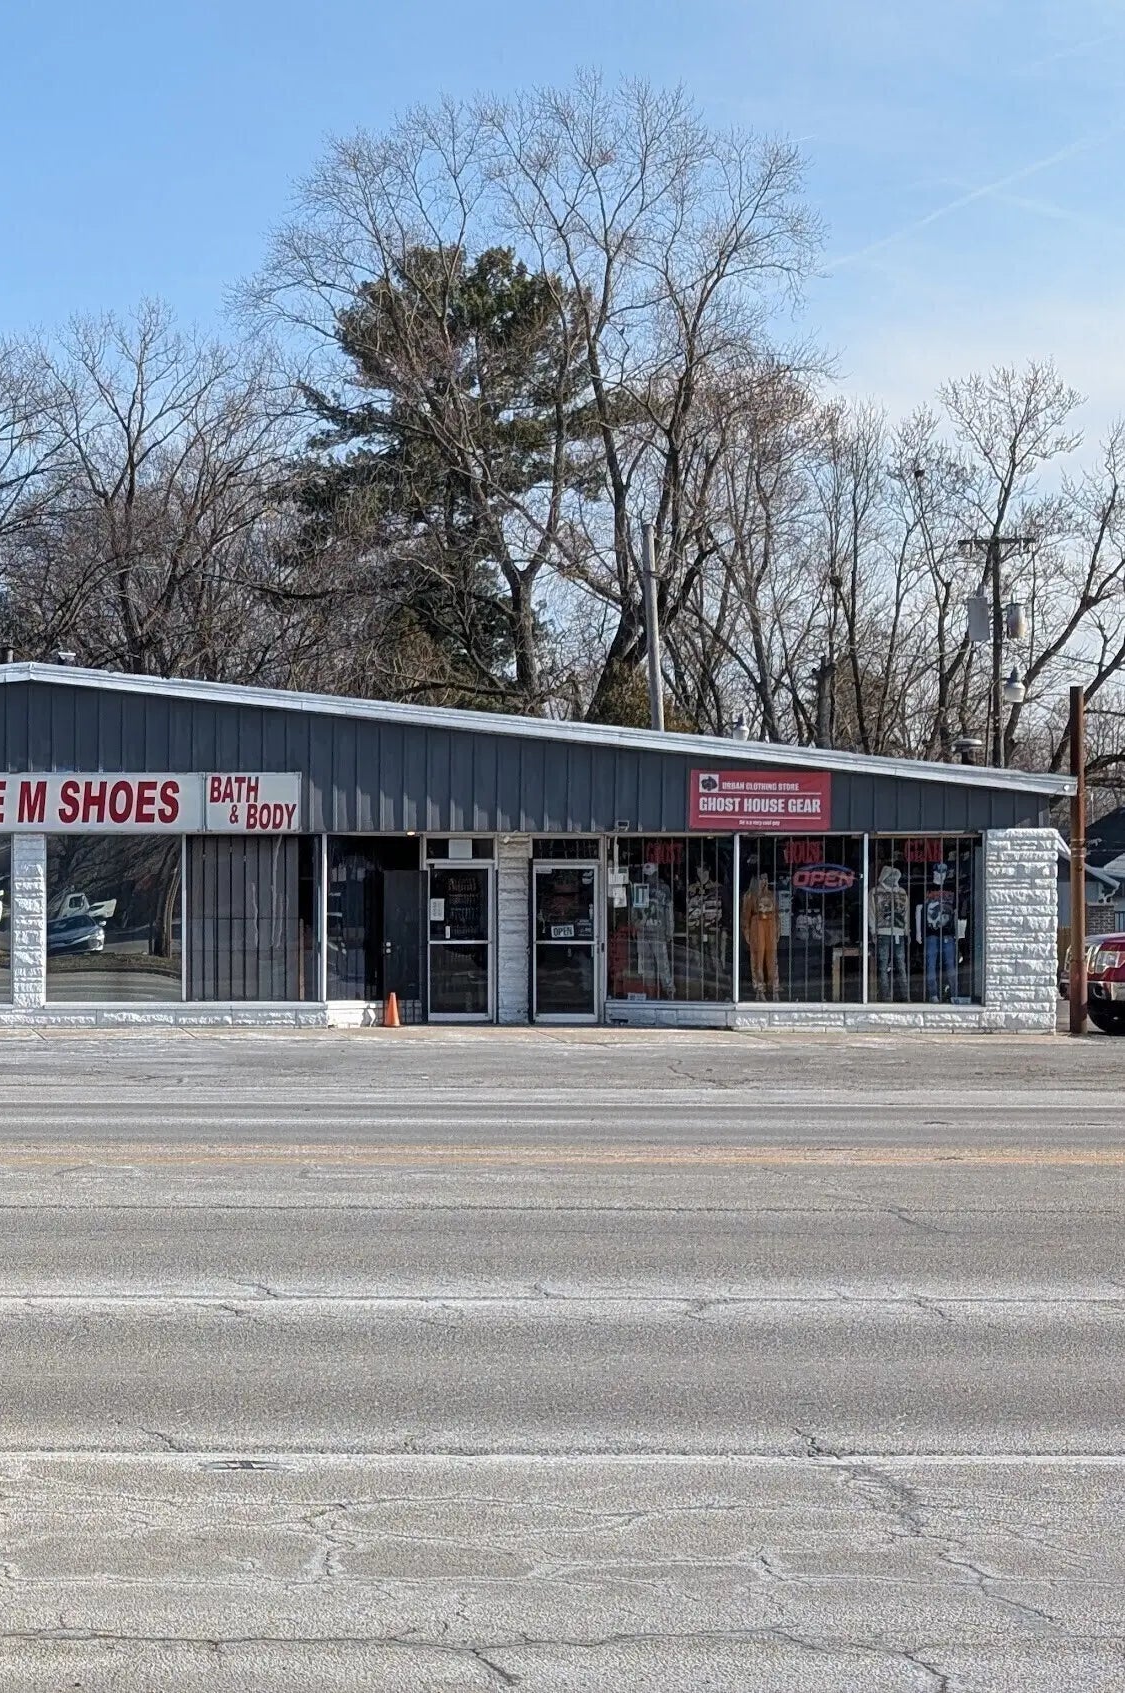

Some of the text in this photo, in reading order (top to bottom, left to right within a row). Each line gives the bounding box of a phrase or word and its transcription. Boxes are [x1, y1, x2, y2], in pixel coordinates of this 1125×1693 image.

[209, 776, 260, 803] BATH
[722, 781, 800, 791] URBAN CLOTHING STORE
[17, 780, 48, 823] M
[58, 780, 181, 824] SHOES
[699, 797, 822, 813] GHOST HOUSE GEAR
[229, 803, 297, 830] & BODY
[793, 870, 855, 888] OPEN
[553, 926, 573, 936] OPEN
